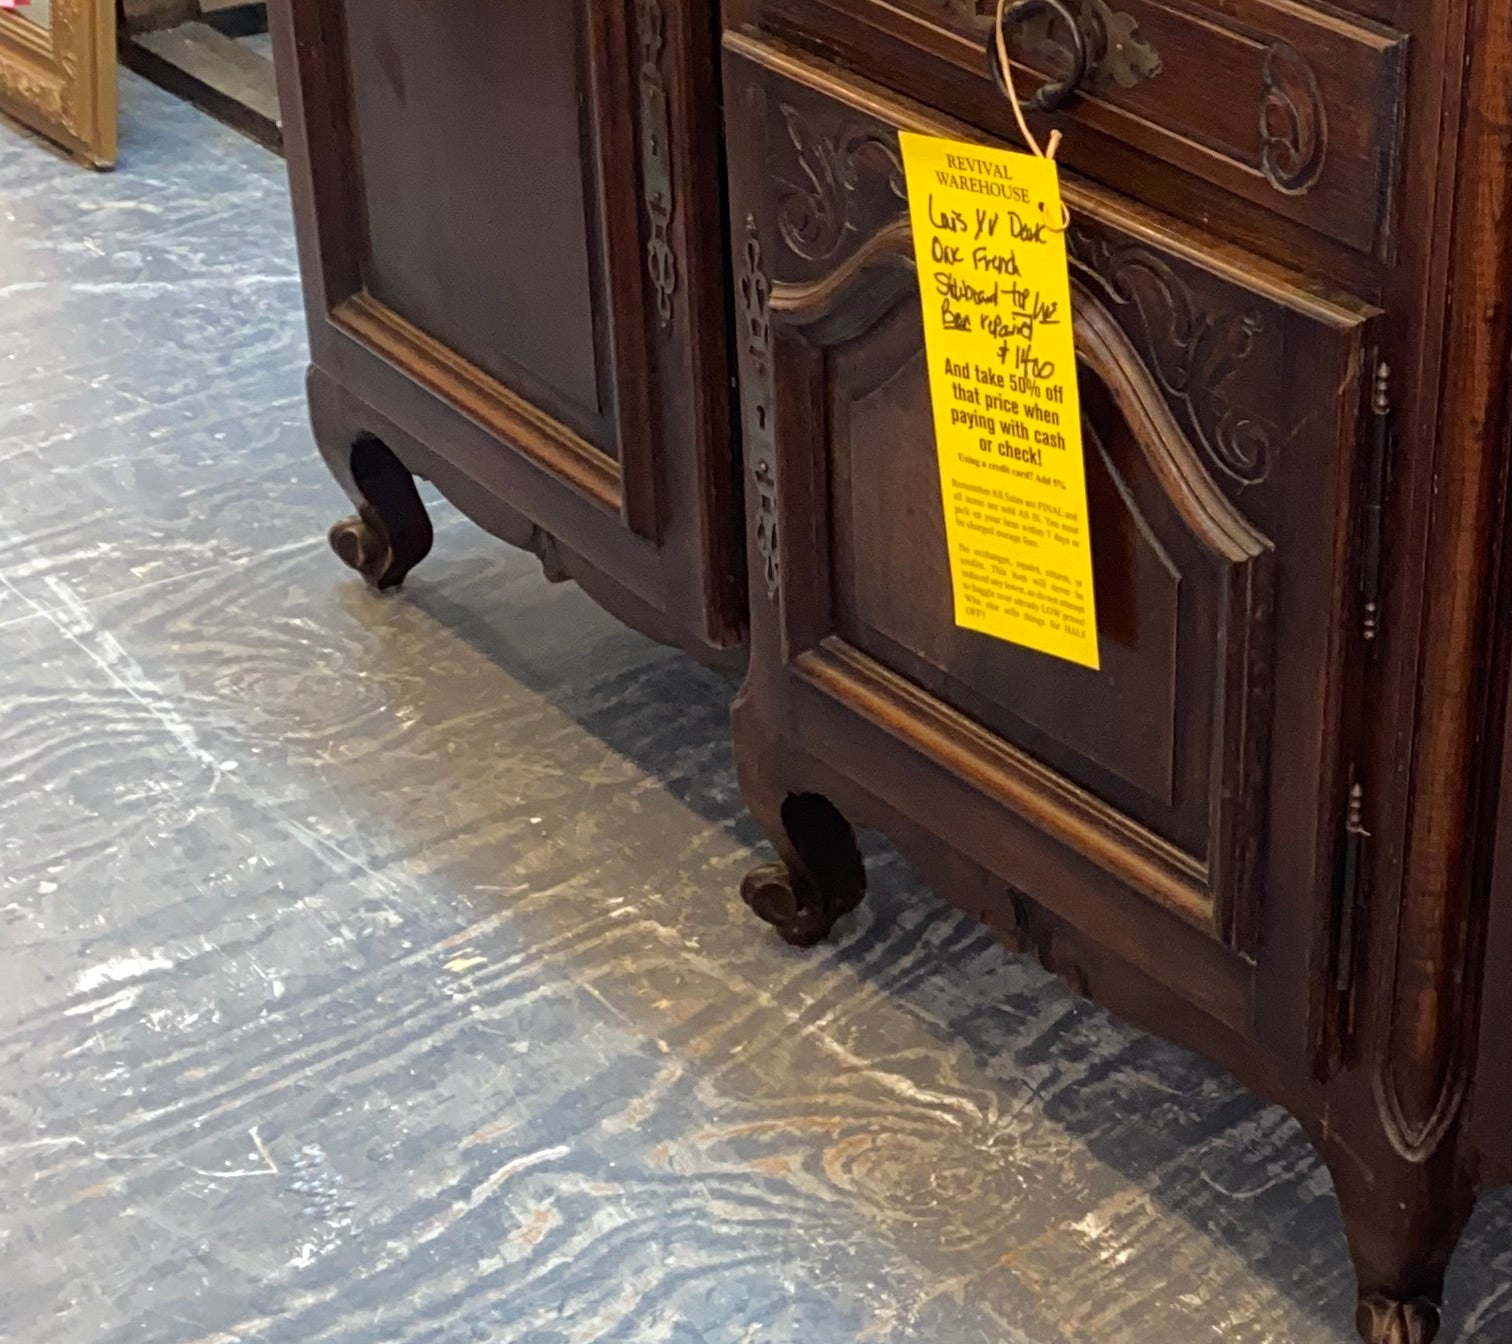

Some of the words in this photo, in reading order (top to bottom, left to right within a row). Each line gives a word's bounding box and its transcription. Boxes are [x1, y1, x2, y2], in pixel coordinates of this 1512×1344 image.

[946, 153, 1013, 181] REVIVAL
[935, 170, 1030, 204] WAREHOUSE
[945, 357, 970, 380] And
[975, 364, 1005, 388] take
[1009, 373, 1041, 398] 50%
[1045, 384, 1063, 404] off
[952, 382, 981, 405] that
[985, 393, 1019, 416] price
[1023, 402, 1060, 426] when
[951, 408, 995, 435] paying
[999, 419, 1029, 441] with
[1034, 429, 1065, 451] cash
[979, 437, 992, 453] or
[998, 440, 1042, 467] check!
